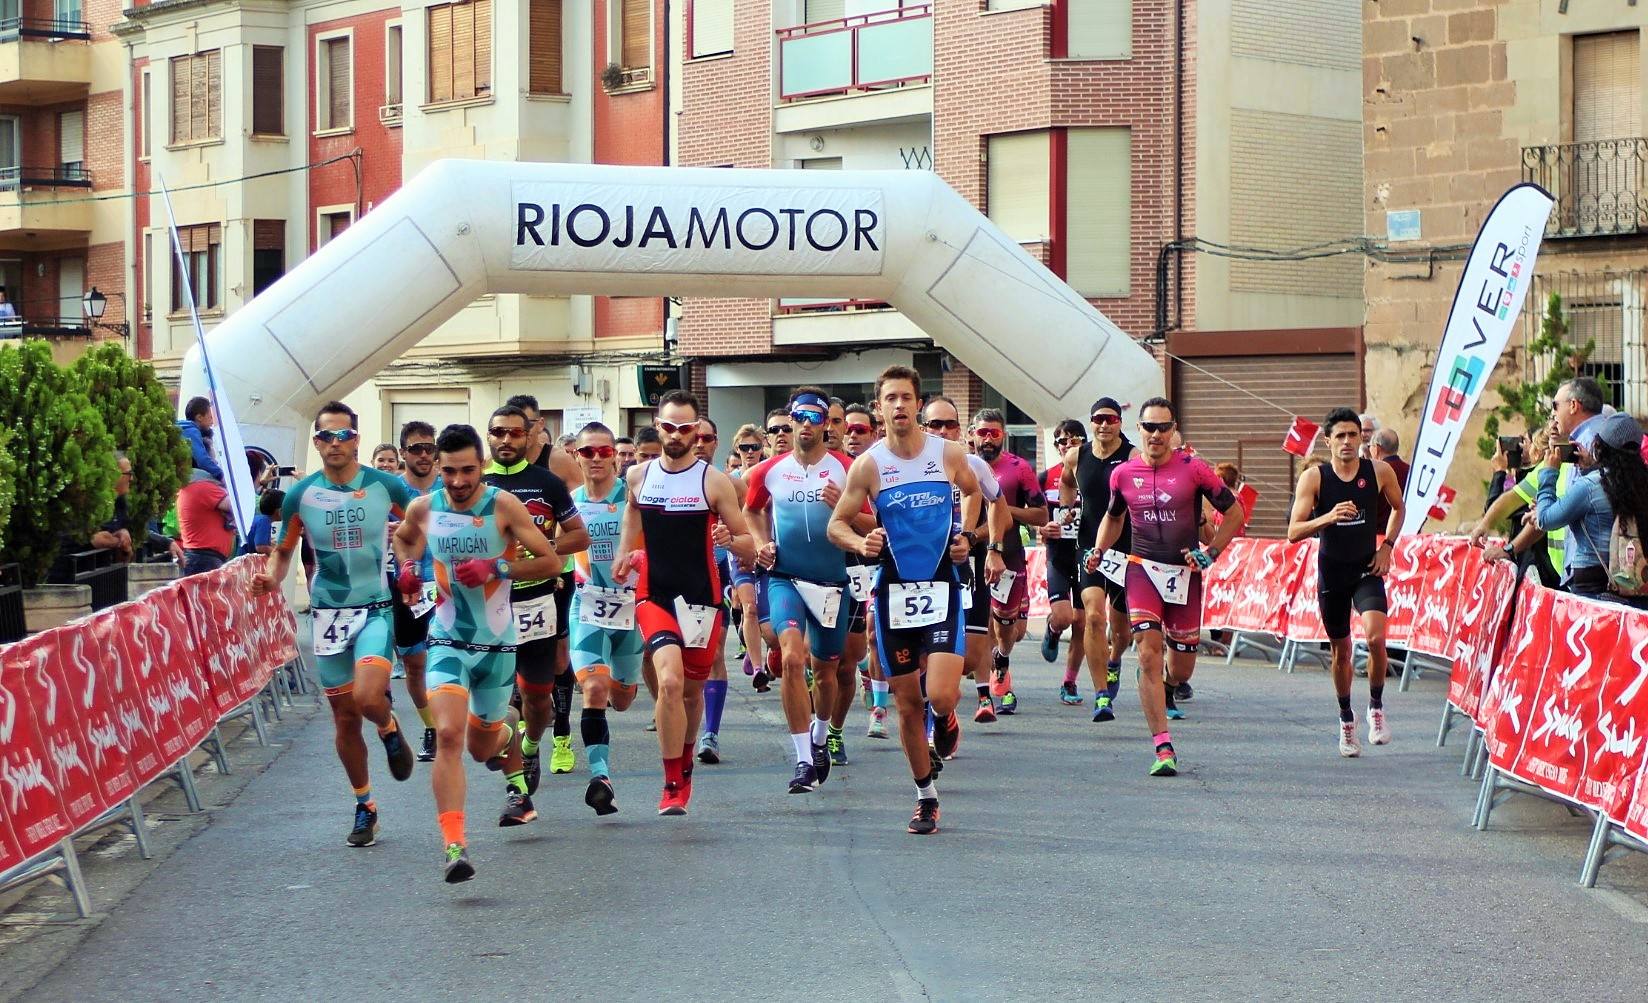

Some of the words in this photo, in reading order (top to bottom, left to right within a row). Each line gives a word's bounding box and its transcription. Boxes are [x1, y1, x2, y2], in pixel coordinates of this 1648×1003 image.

[1515, 225, 1533, 264] sport
[1417, 242, 1516, 498] CLOVER
[326, 507, 366, 526] DIEGO
[1144, 510, 1177, 522] RAULY
[587, 521, 621, 538] GOMEZ
[437, 533, 489, 553] MARUGÁN
[1166, 576, 1177, 592] 4
[593, 600, 623, 619] 37
[904, 595, 934, 617] 52
[518, 610, 546, 633] 54
[323, 624, 350, 644] 41
